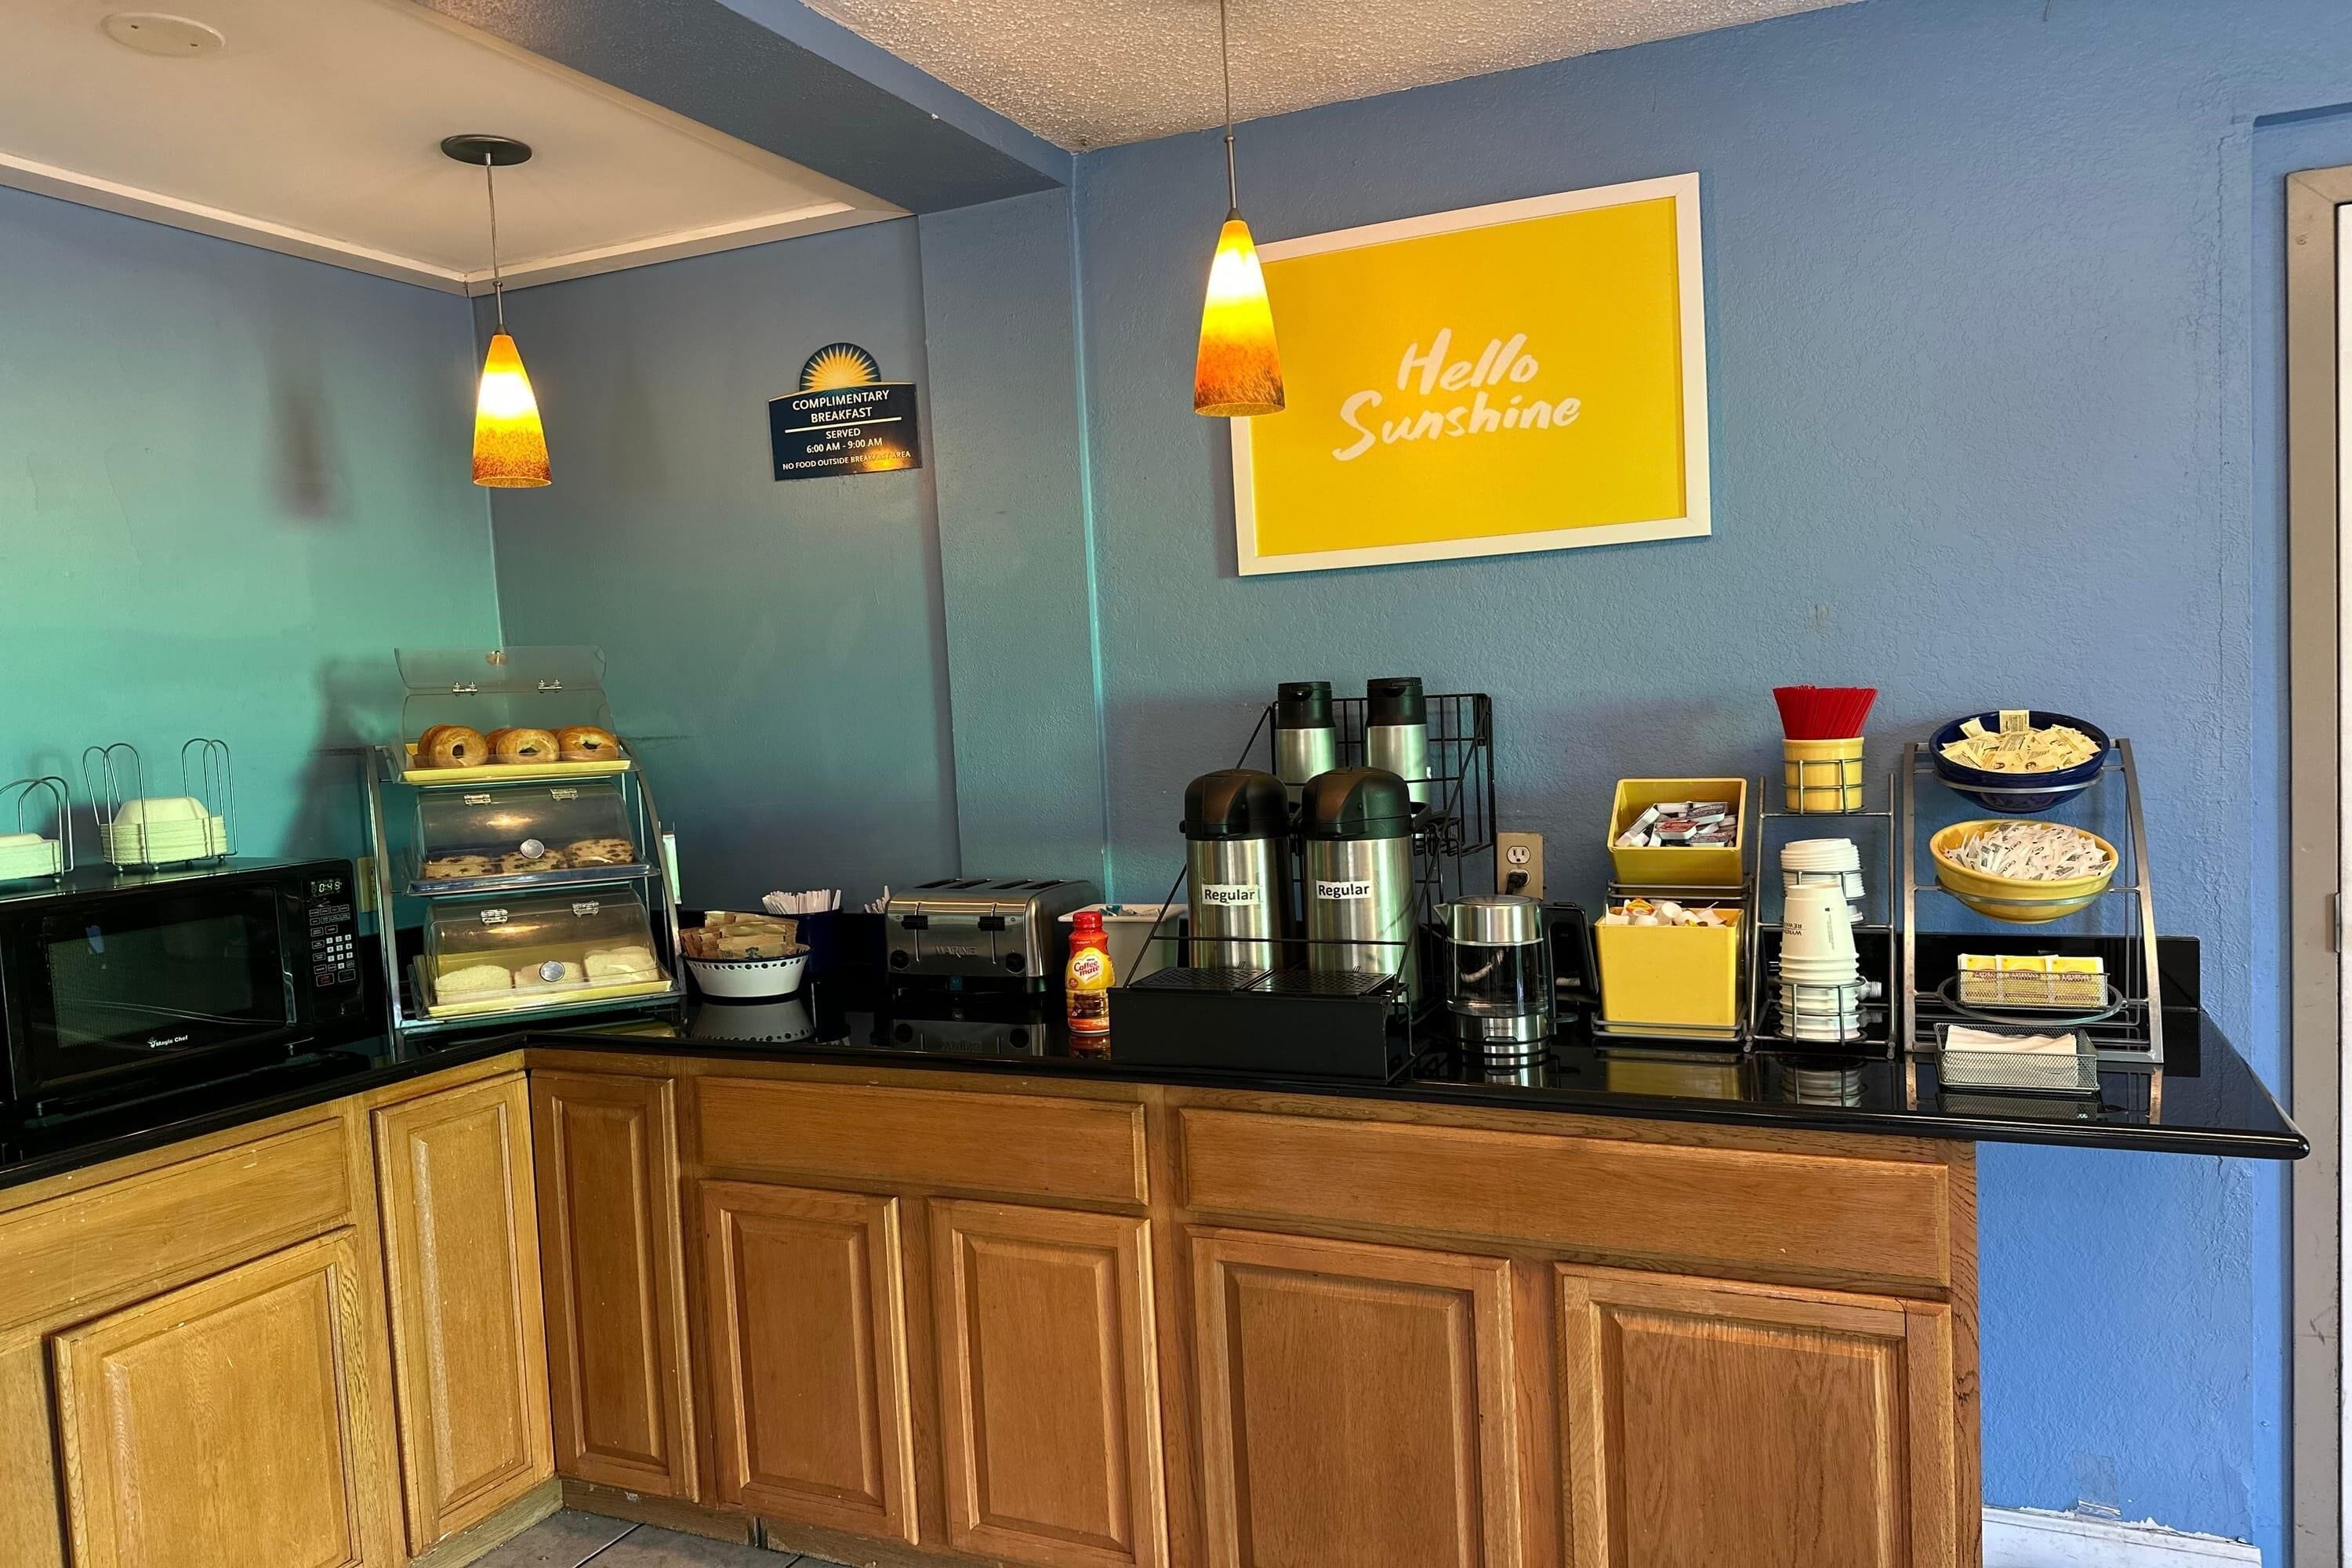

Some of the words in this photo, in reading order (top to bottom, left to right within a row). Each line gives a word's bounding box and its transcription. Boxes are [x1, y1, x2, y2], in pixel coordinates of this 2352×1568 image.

[1396, 327, 1539, 396] Hello
[792, 390, 891, 411] COMPLIMENTARY
[811, 406, 873, 423] BREAKFAST
[826, 427, 861, 440] SERVED
[1331, 390, 1581, 462] Sunshine
[806, 445, 824, 453] 6:00
[826, 441, 840, 452] AM
[848, 440, 866, 449] 9:00
[867, 437, 883, 447] AM
[796, 459, 816, 468] FOOD
[818, 457, 849, 466] OUTSIDE
[850, 452, 891, 463] BREAKFAST
[892, 450, 911, 459] AREA
[1204, 888, 1255, 903] Regular
[1318, 884, 1370, 898] Regular
[1074, 960, 1098, 972] Coffee
[1079, 965, 1100, 976] mate
